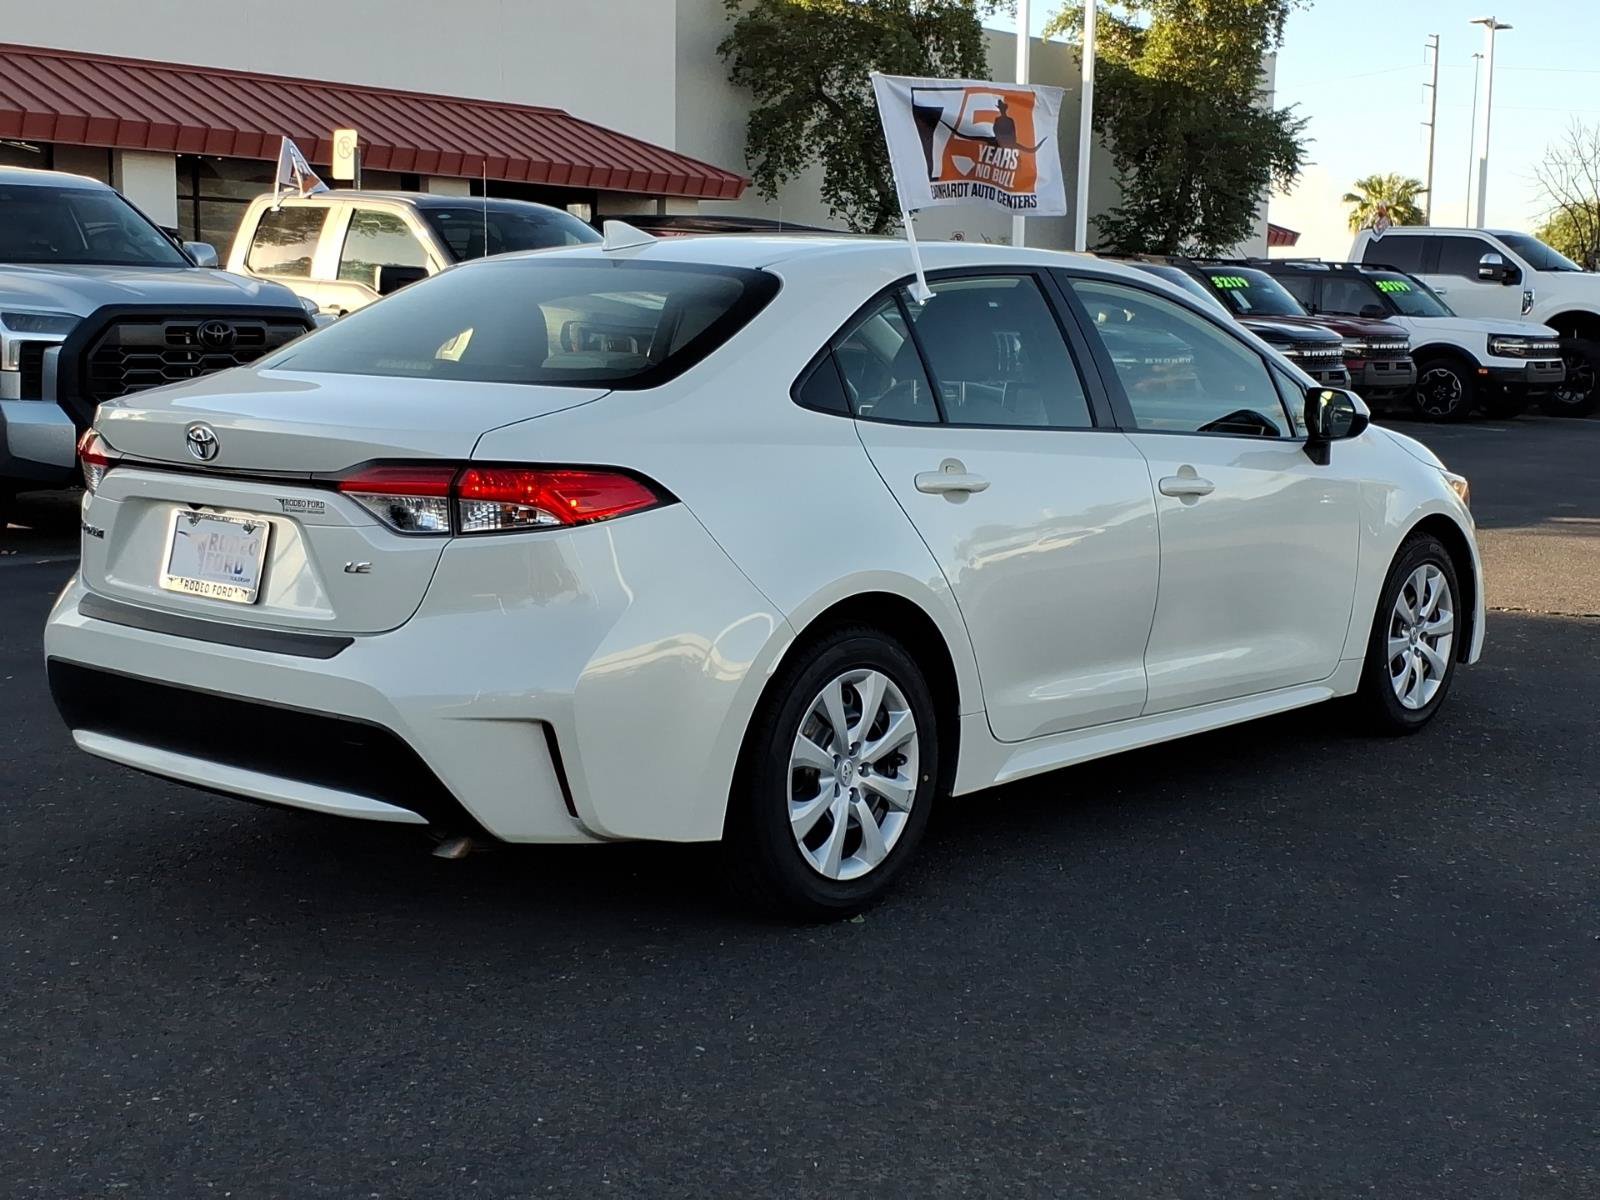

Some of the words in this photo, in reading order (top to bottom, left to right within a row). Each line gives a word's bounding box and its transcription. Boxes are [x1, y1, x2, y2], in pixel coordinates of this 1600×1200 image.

[978, 144, 1019, 170] YEARS
[975, 163, 991, 179] NO
[992, 167, 1015, 188] BULL
[971, 183, 996, 201] AUTO
[997, 190, 1038, 209] CENTERS
[284, 498, 307, 508] RODEO
[307, 500, 325, 509] FORD
[183, 579, 210, 594] RODEO
[212, 584, 233, 598] FORD
